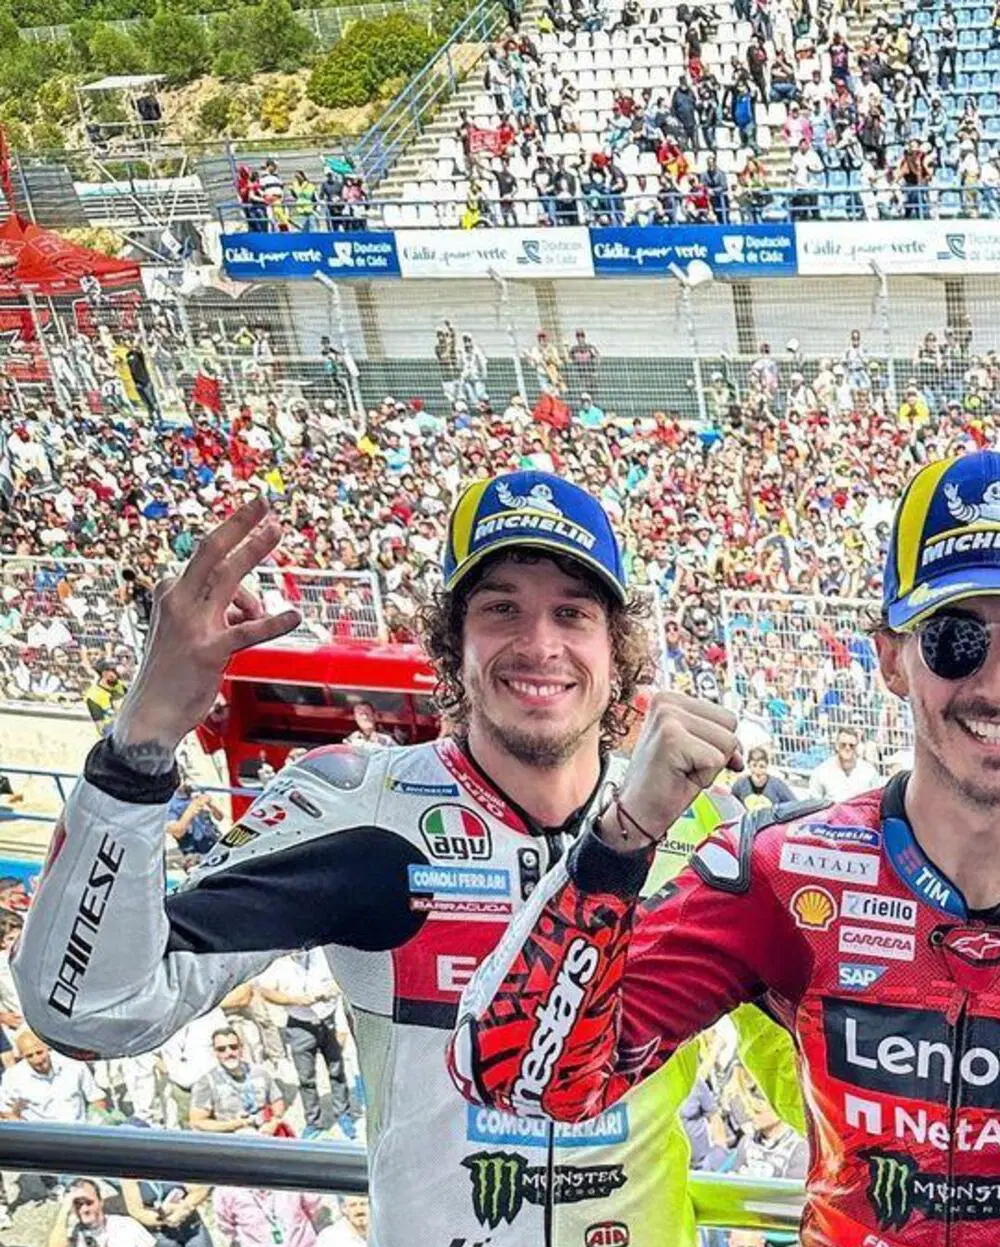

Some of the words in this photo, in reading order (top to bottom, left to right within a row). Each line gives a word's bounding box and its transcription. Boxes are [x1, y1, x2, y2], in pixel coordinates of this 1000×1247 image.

[474, 515, 597, 551] MICHELIN
[790, 852, 870, 876] EATALY
[414, 870, 457, 888] COMOLI
[458, 873, 507, 889] FERRARI
[915, 866, 951, 908] TIM
[413, 900, 510, 913] BARRACUDA
[864, 897, 913, 921] riello
[48, 832, 125, 1019] DAINESE
[842, 931, 913, 951] CARRERA
[839, 966, 877, 987] SAP
[522, 1171, 622, 1189] MONSTER
